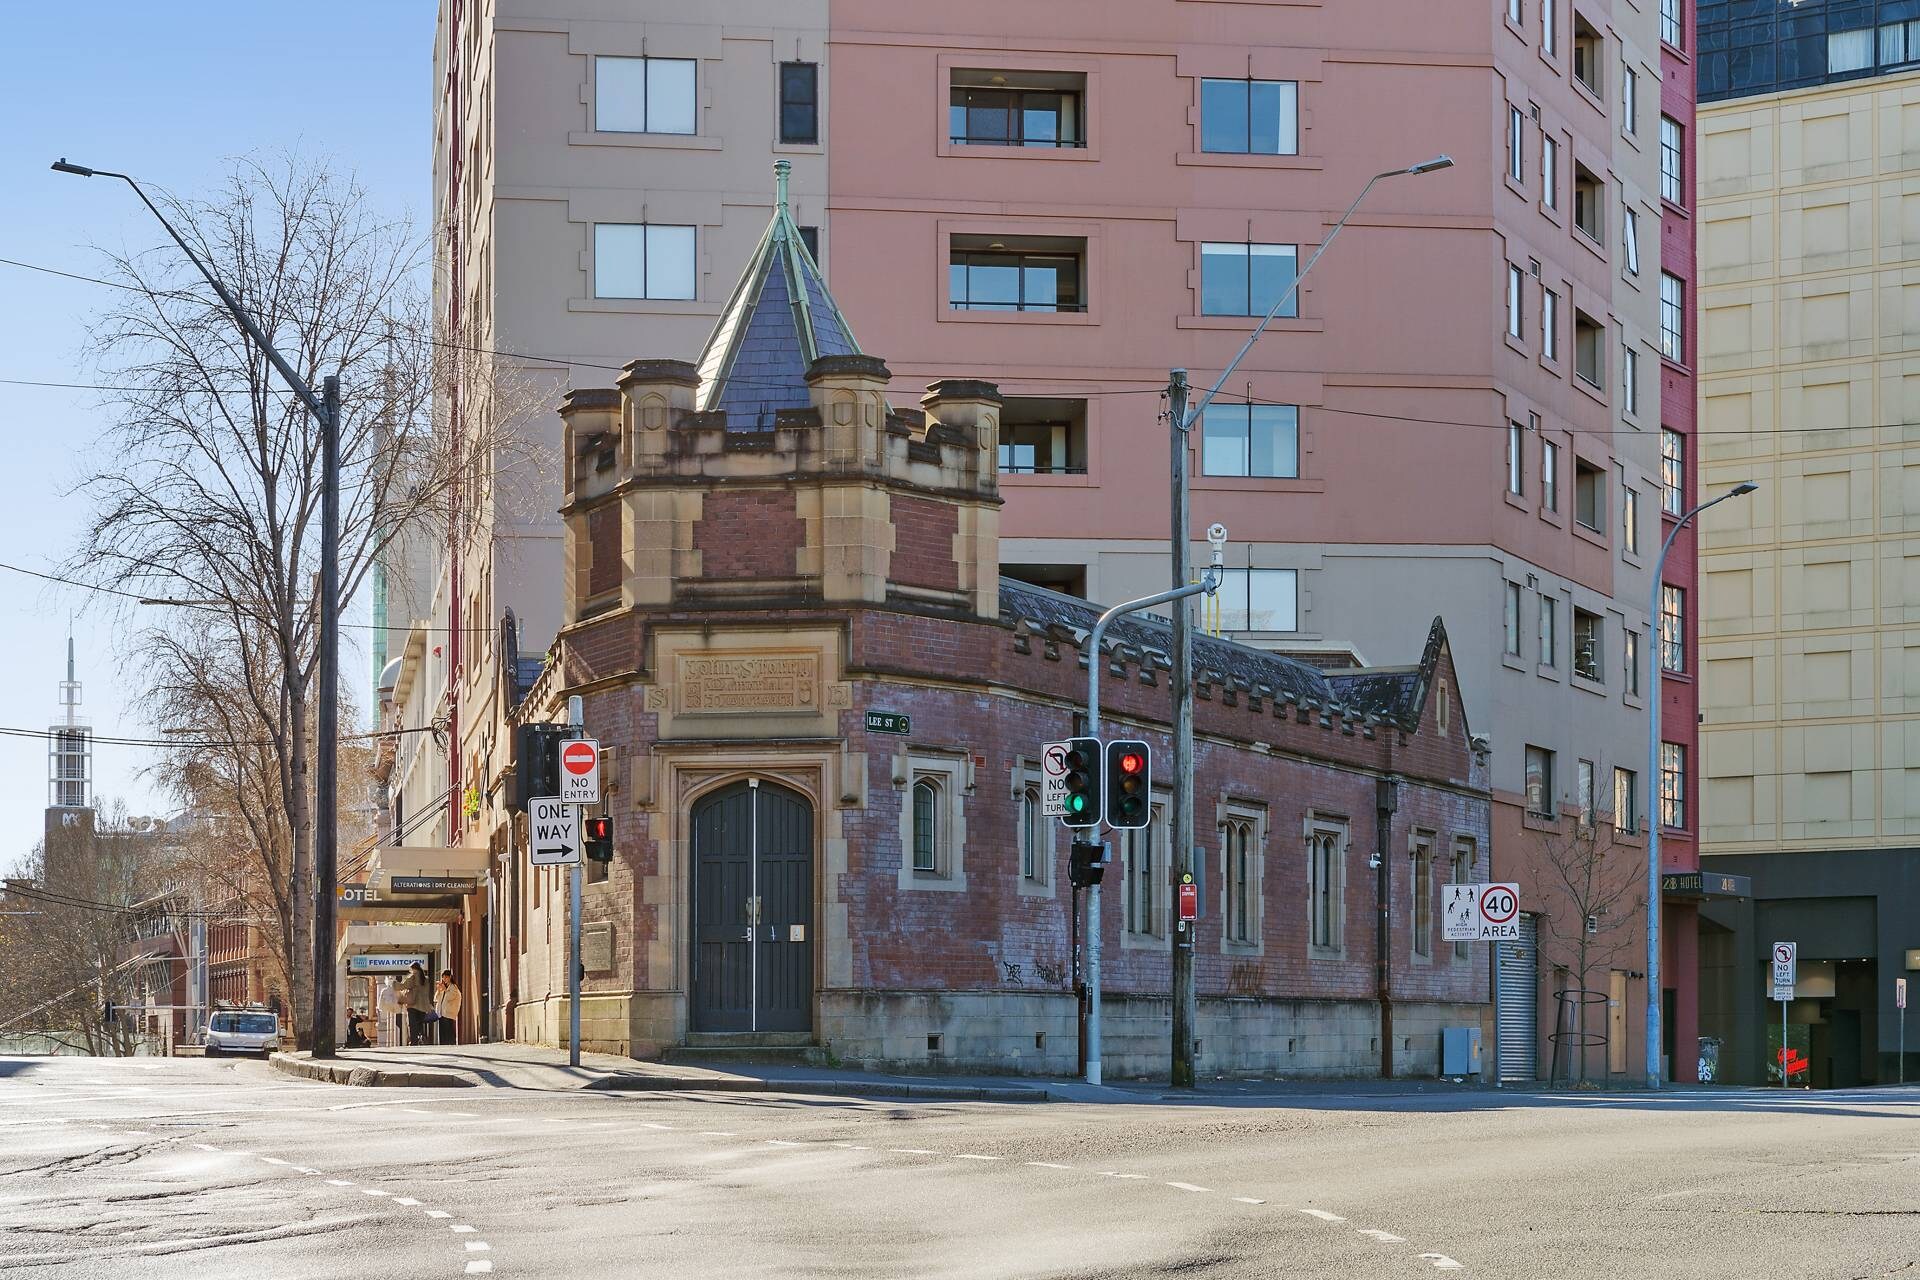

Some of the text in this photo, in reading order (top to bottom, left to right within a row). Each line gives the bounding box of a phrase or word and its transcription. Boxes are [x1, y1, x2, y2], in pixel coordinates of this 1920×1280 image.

[869, 717, 894, 727] LEE ST
[571, 778, 588, 787] NO
[1048, 779, 1065, 791] NO
[564, 790, 595, 799] ENTRY
[1046, 793, 1068, 802] LEFT
[537, 804, 571, 819] ONE
[537, 824, 571, 840] WAY
[1663, 876, 1703, 890] 28 HOTEL
[339, 889, 382, 901] OTEL
[1485, 895, 1513, 914] 40
[1482, 926, 1518, 937] AREA
